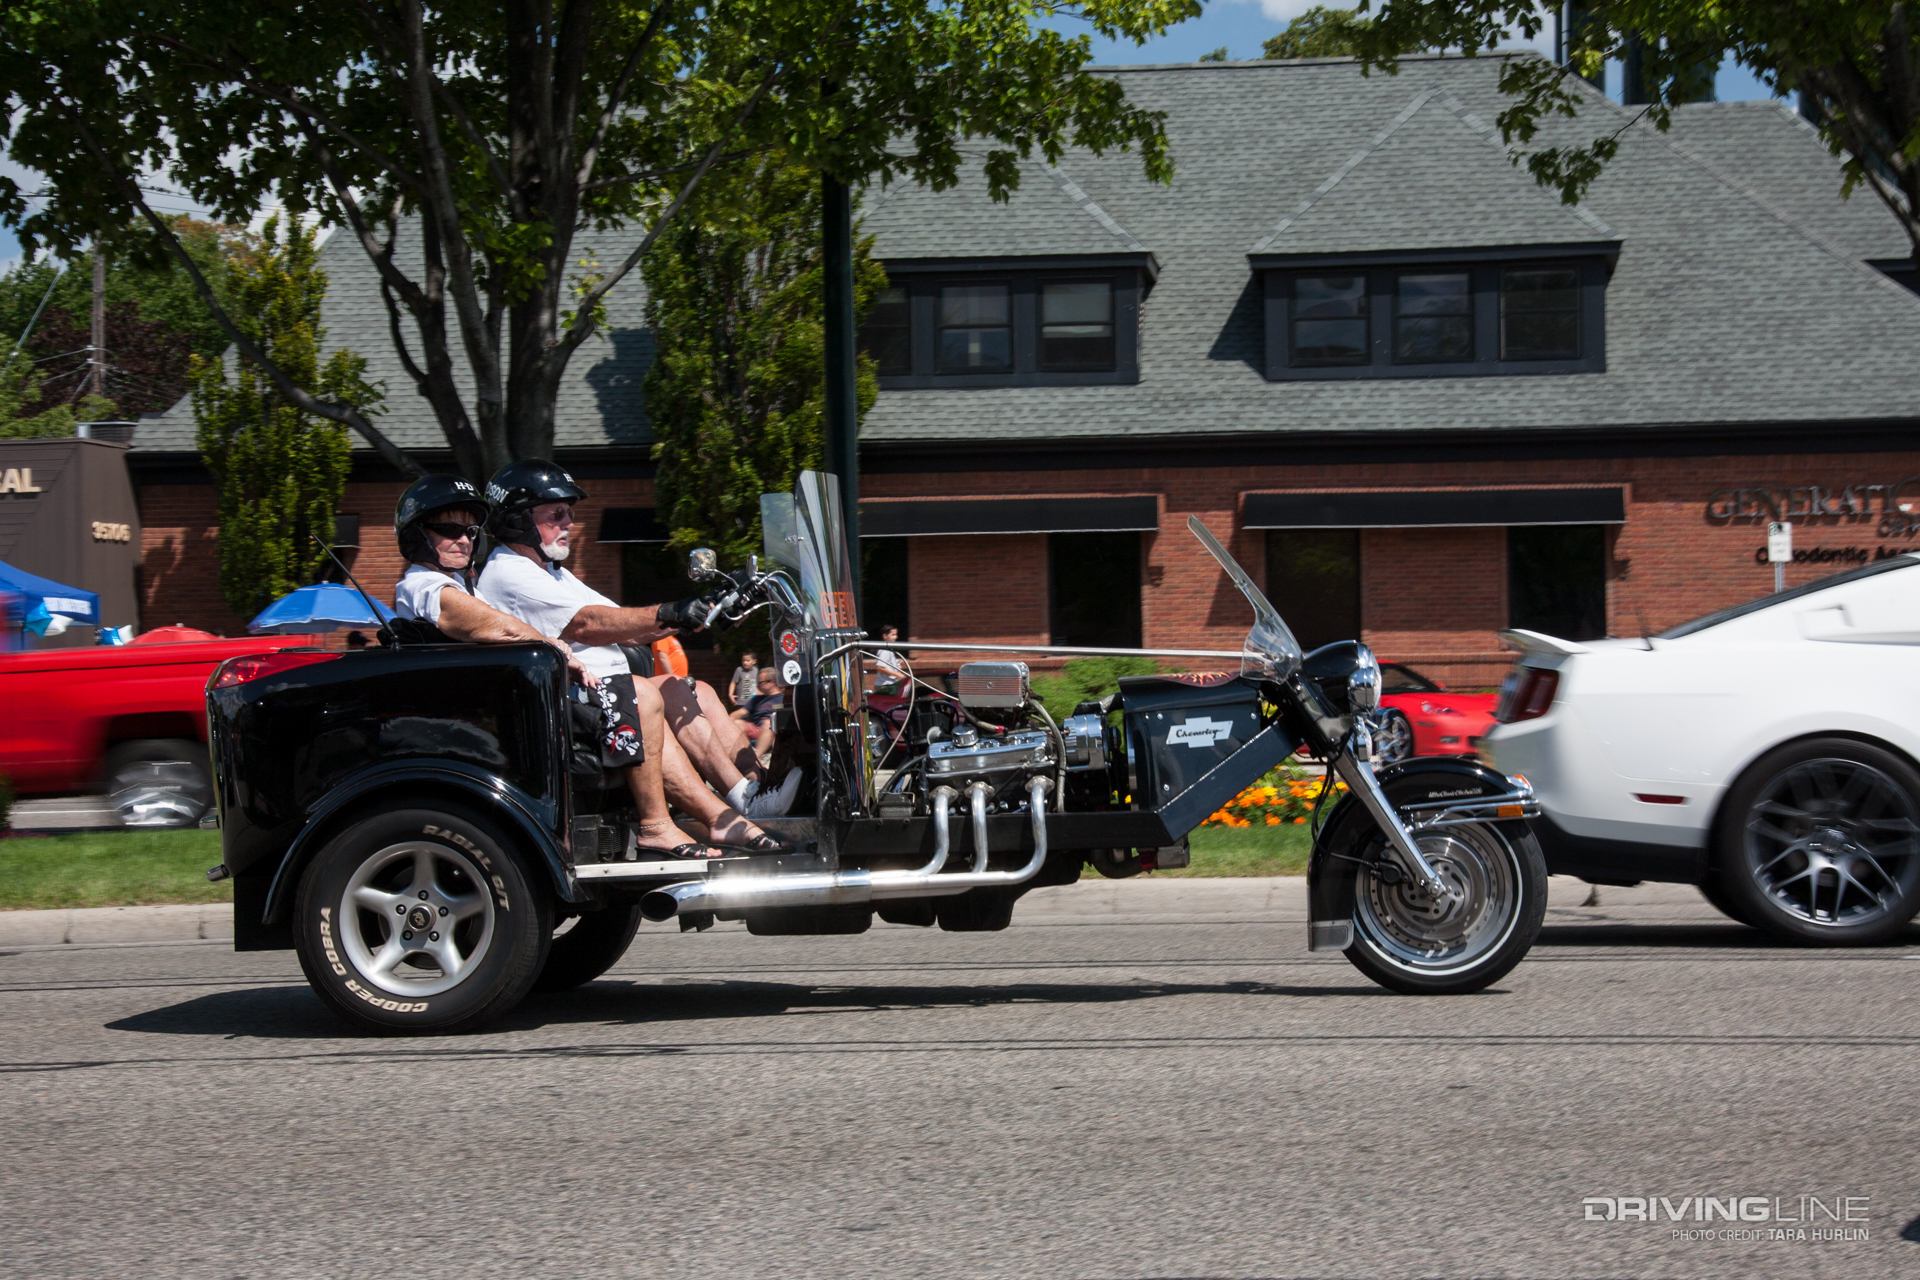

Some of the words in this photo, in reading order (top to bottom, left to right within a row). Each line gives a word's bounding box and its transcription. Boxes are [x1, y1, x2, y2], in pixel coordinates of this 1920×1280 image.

[0, 468, 42, 493] AL
[422, 824, 492, 872] RADIAL
[320, 907, 347, 977] COBRA
[344, 979, 429, 1013] COOPER
